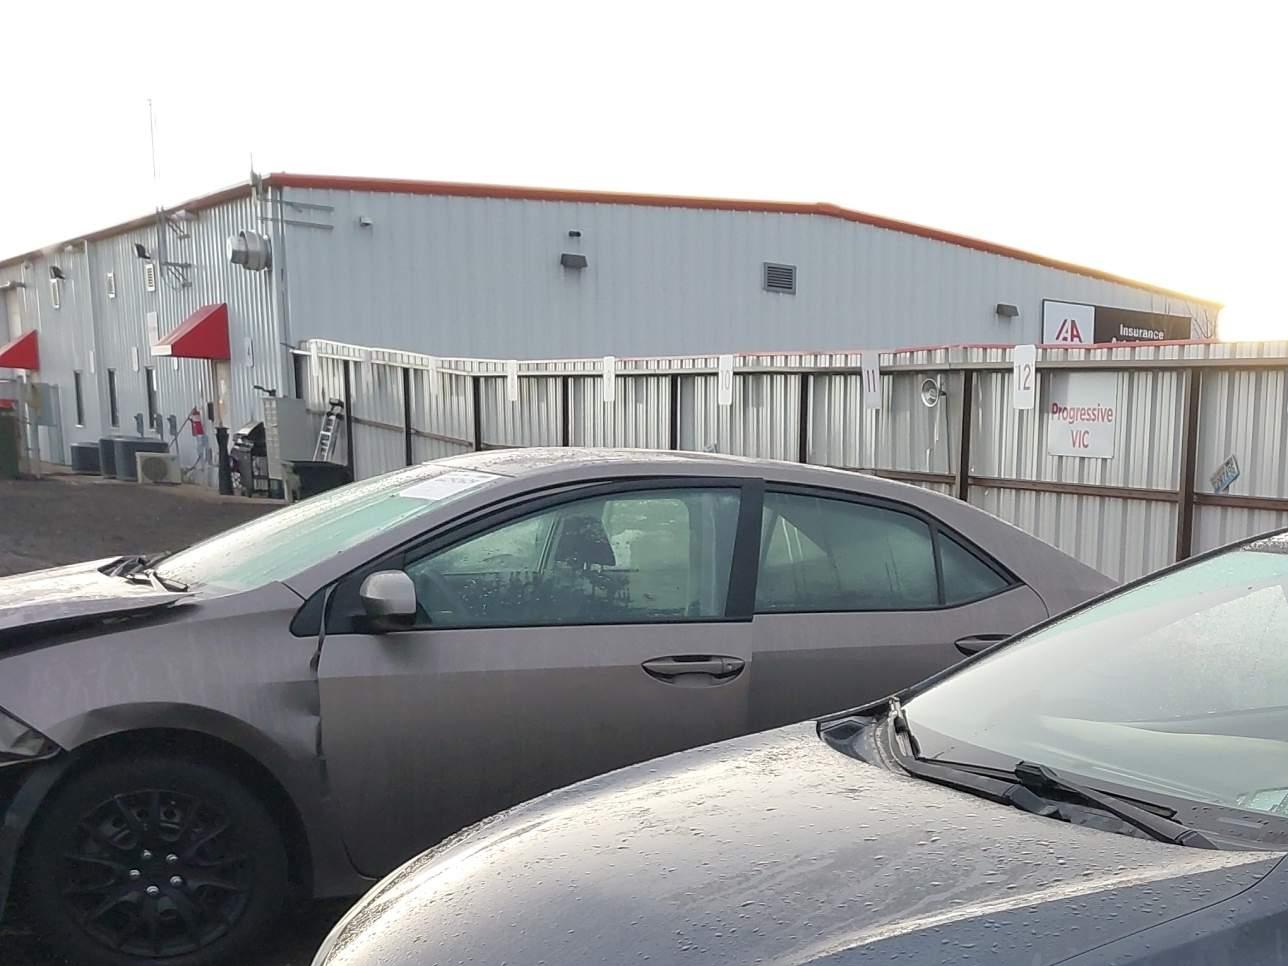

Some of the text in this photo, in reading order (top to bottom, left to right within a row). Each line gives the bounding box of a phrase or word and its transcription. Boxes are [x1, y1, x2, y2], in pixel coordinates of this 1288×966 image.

[1119, 323, 1165, 340] Insurance
[720, 369, 730, 390] 10
[866, 369, 876, 392] 11
[1016, 363, 1031, 391] 12
[1051, 402, 1114, 424] Progressive
[1071, 430, 1090, 449] VIC
